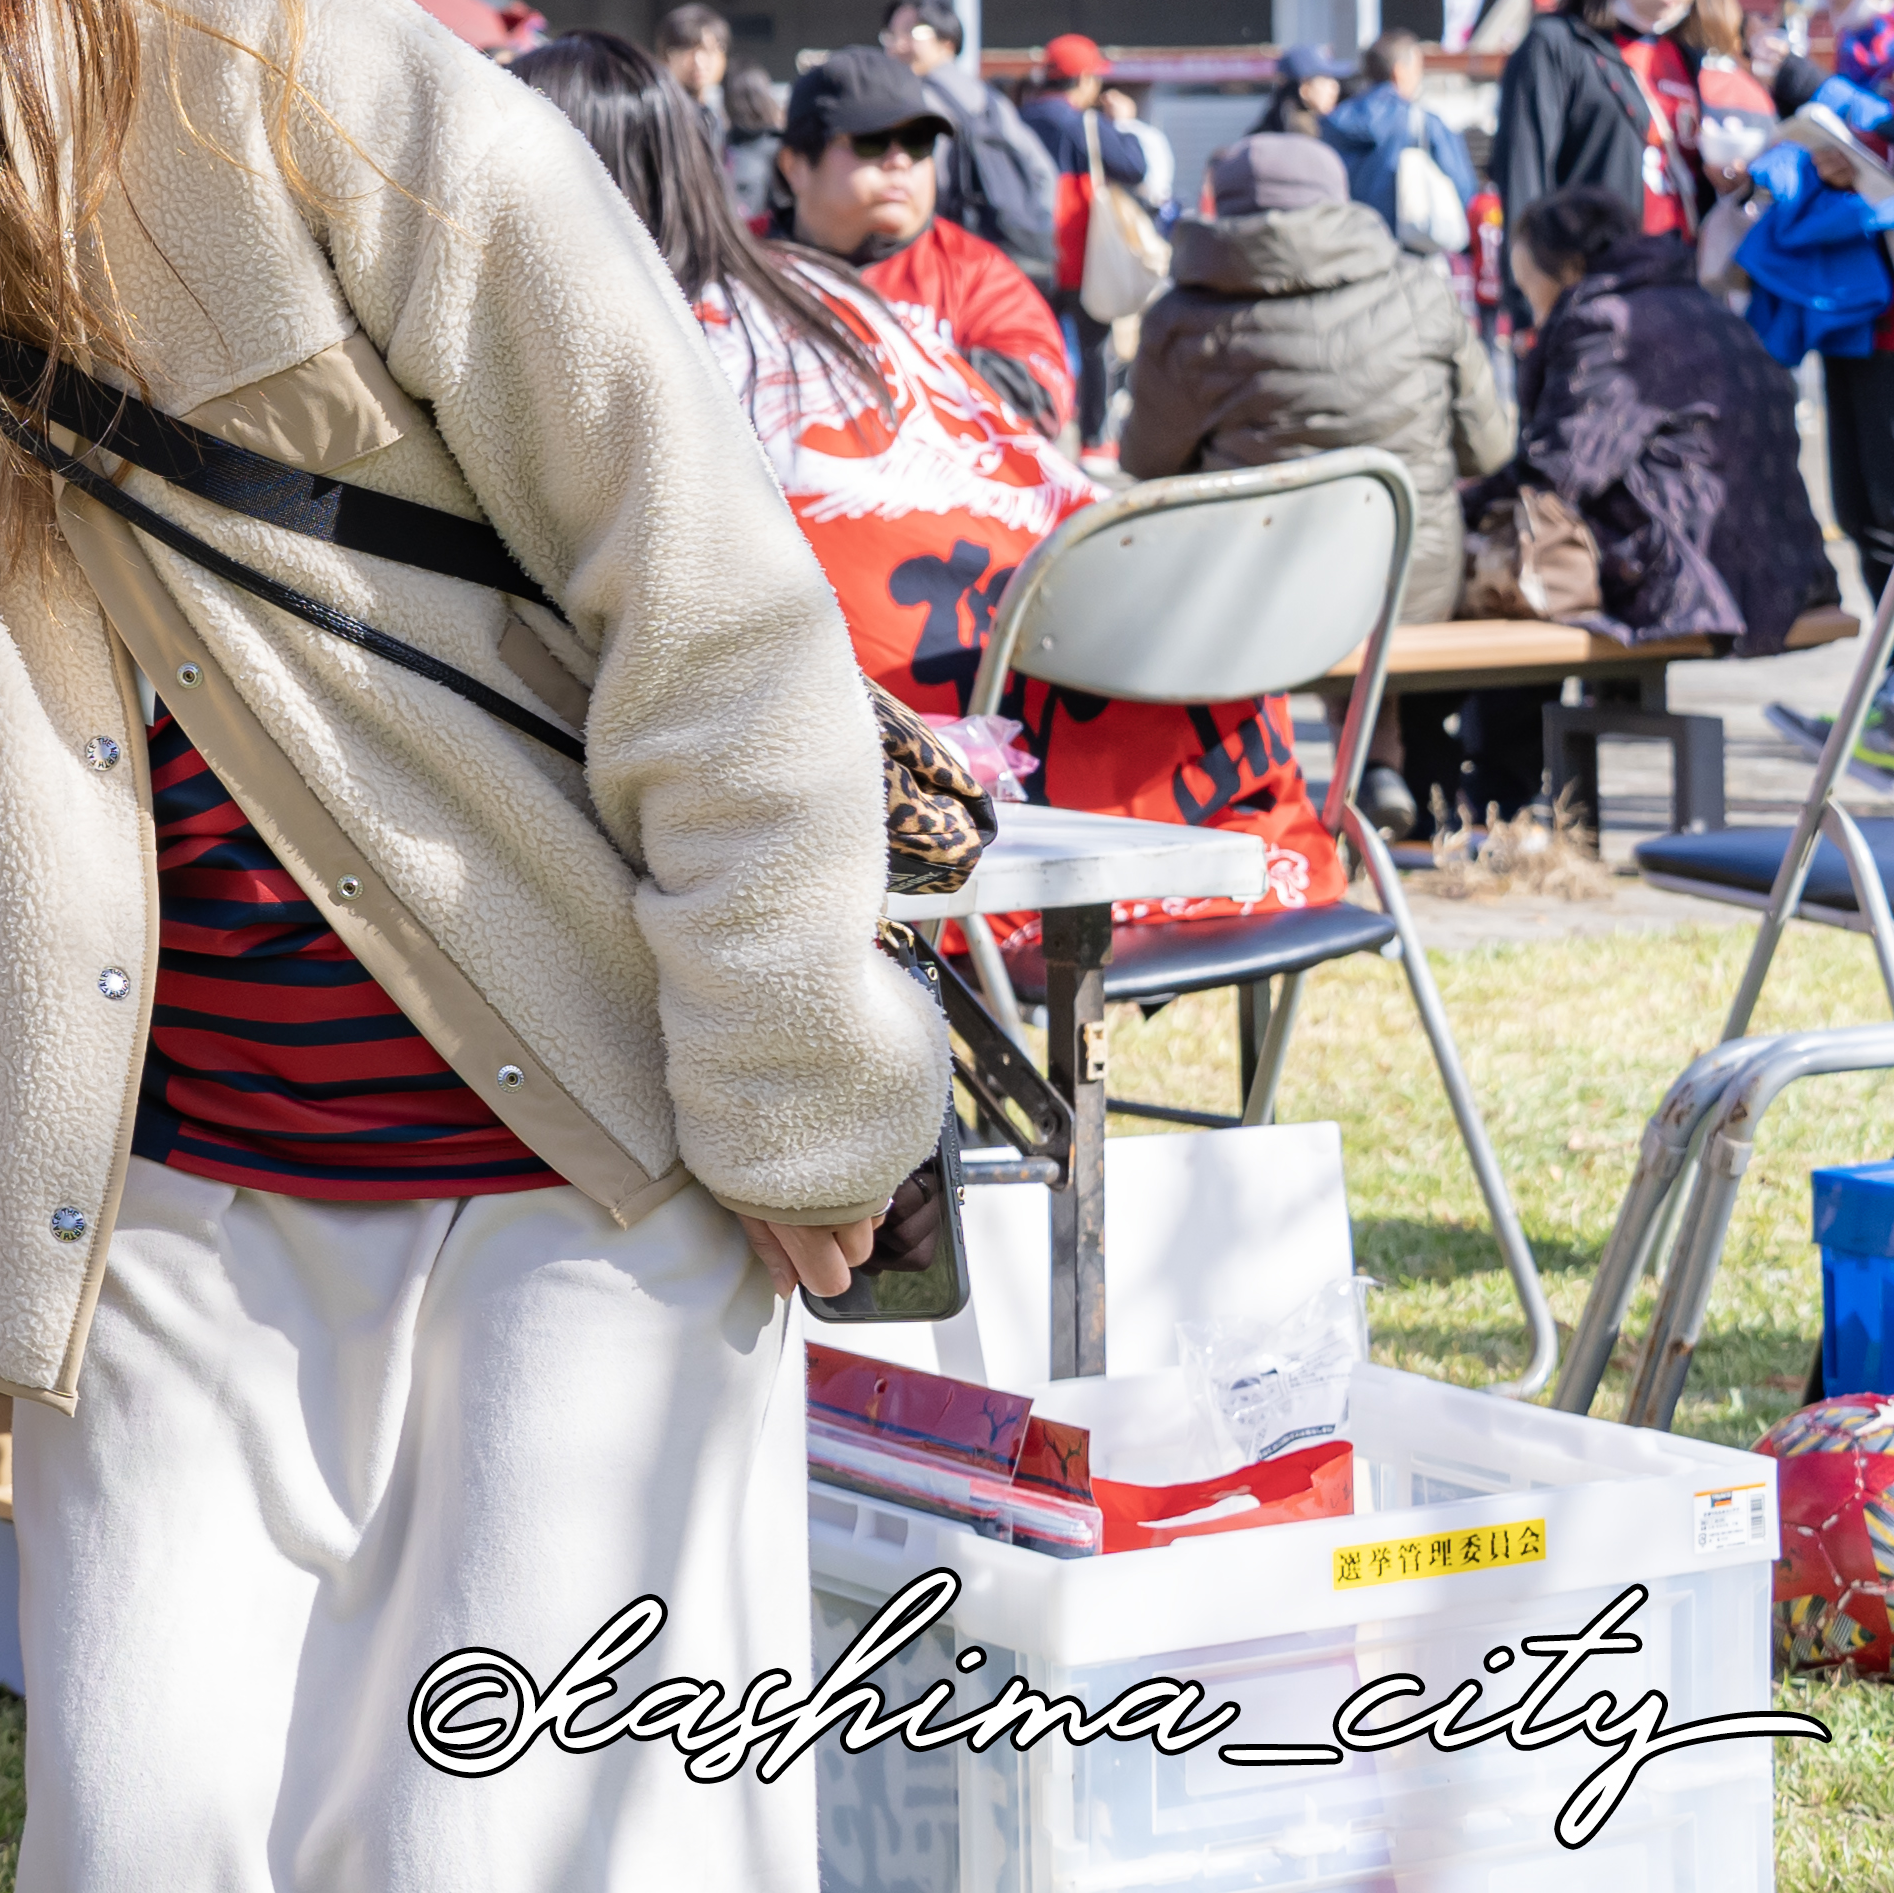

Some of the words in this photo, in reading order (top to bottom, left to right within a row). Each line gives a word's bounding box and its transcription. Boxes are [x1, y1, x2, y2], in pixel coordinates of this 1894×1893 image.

[1337, 1525, 1541, 1583] 選挙管理委員会
